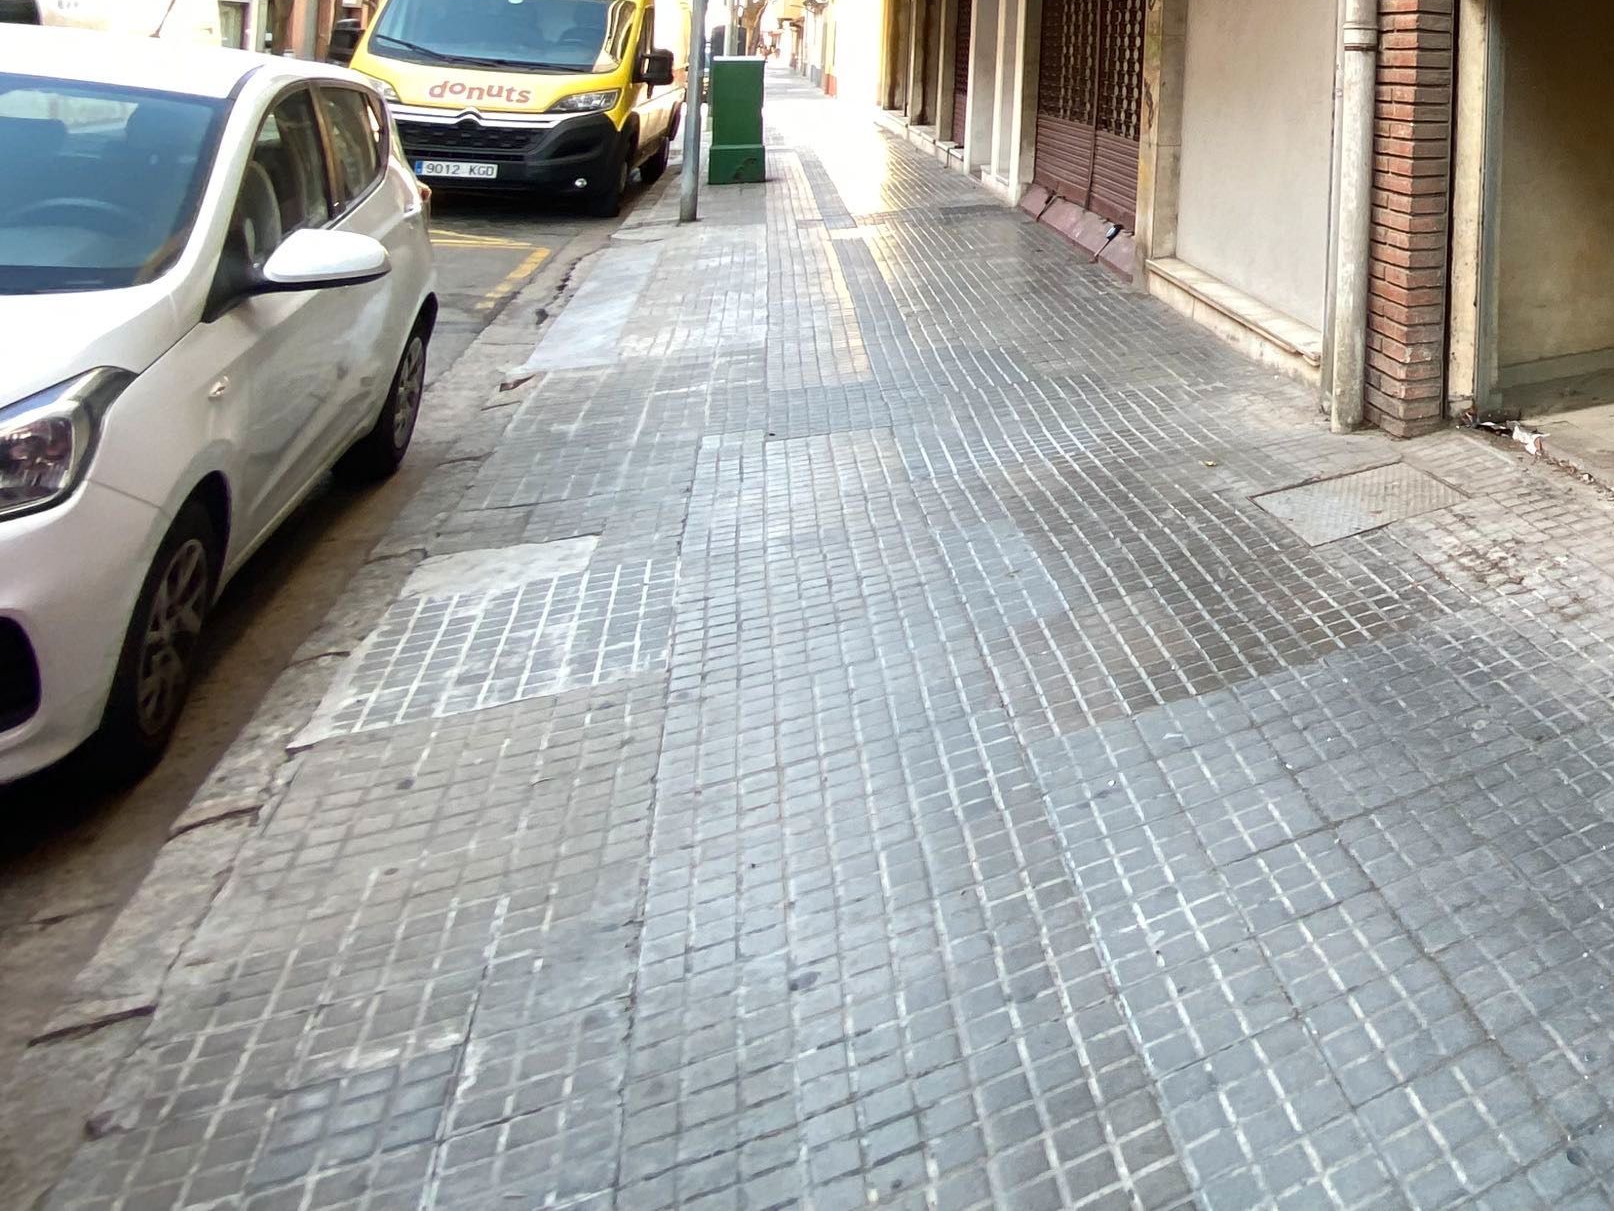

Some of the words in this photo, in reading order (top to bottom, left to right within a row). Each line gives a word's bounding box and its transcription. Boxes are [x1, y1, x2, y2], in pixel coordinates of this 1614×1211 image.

[428, 80, 532, 103] donuts
[426, 163, 460, 175] 9012
[469, 164, 495, 176] KGD
